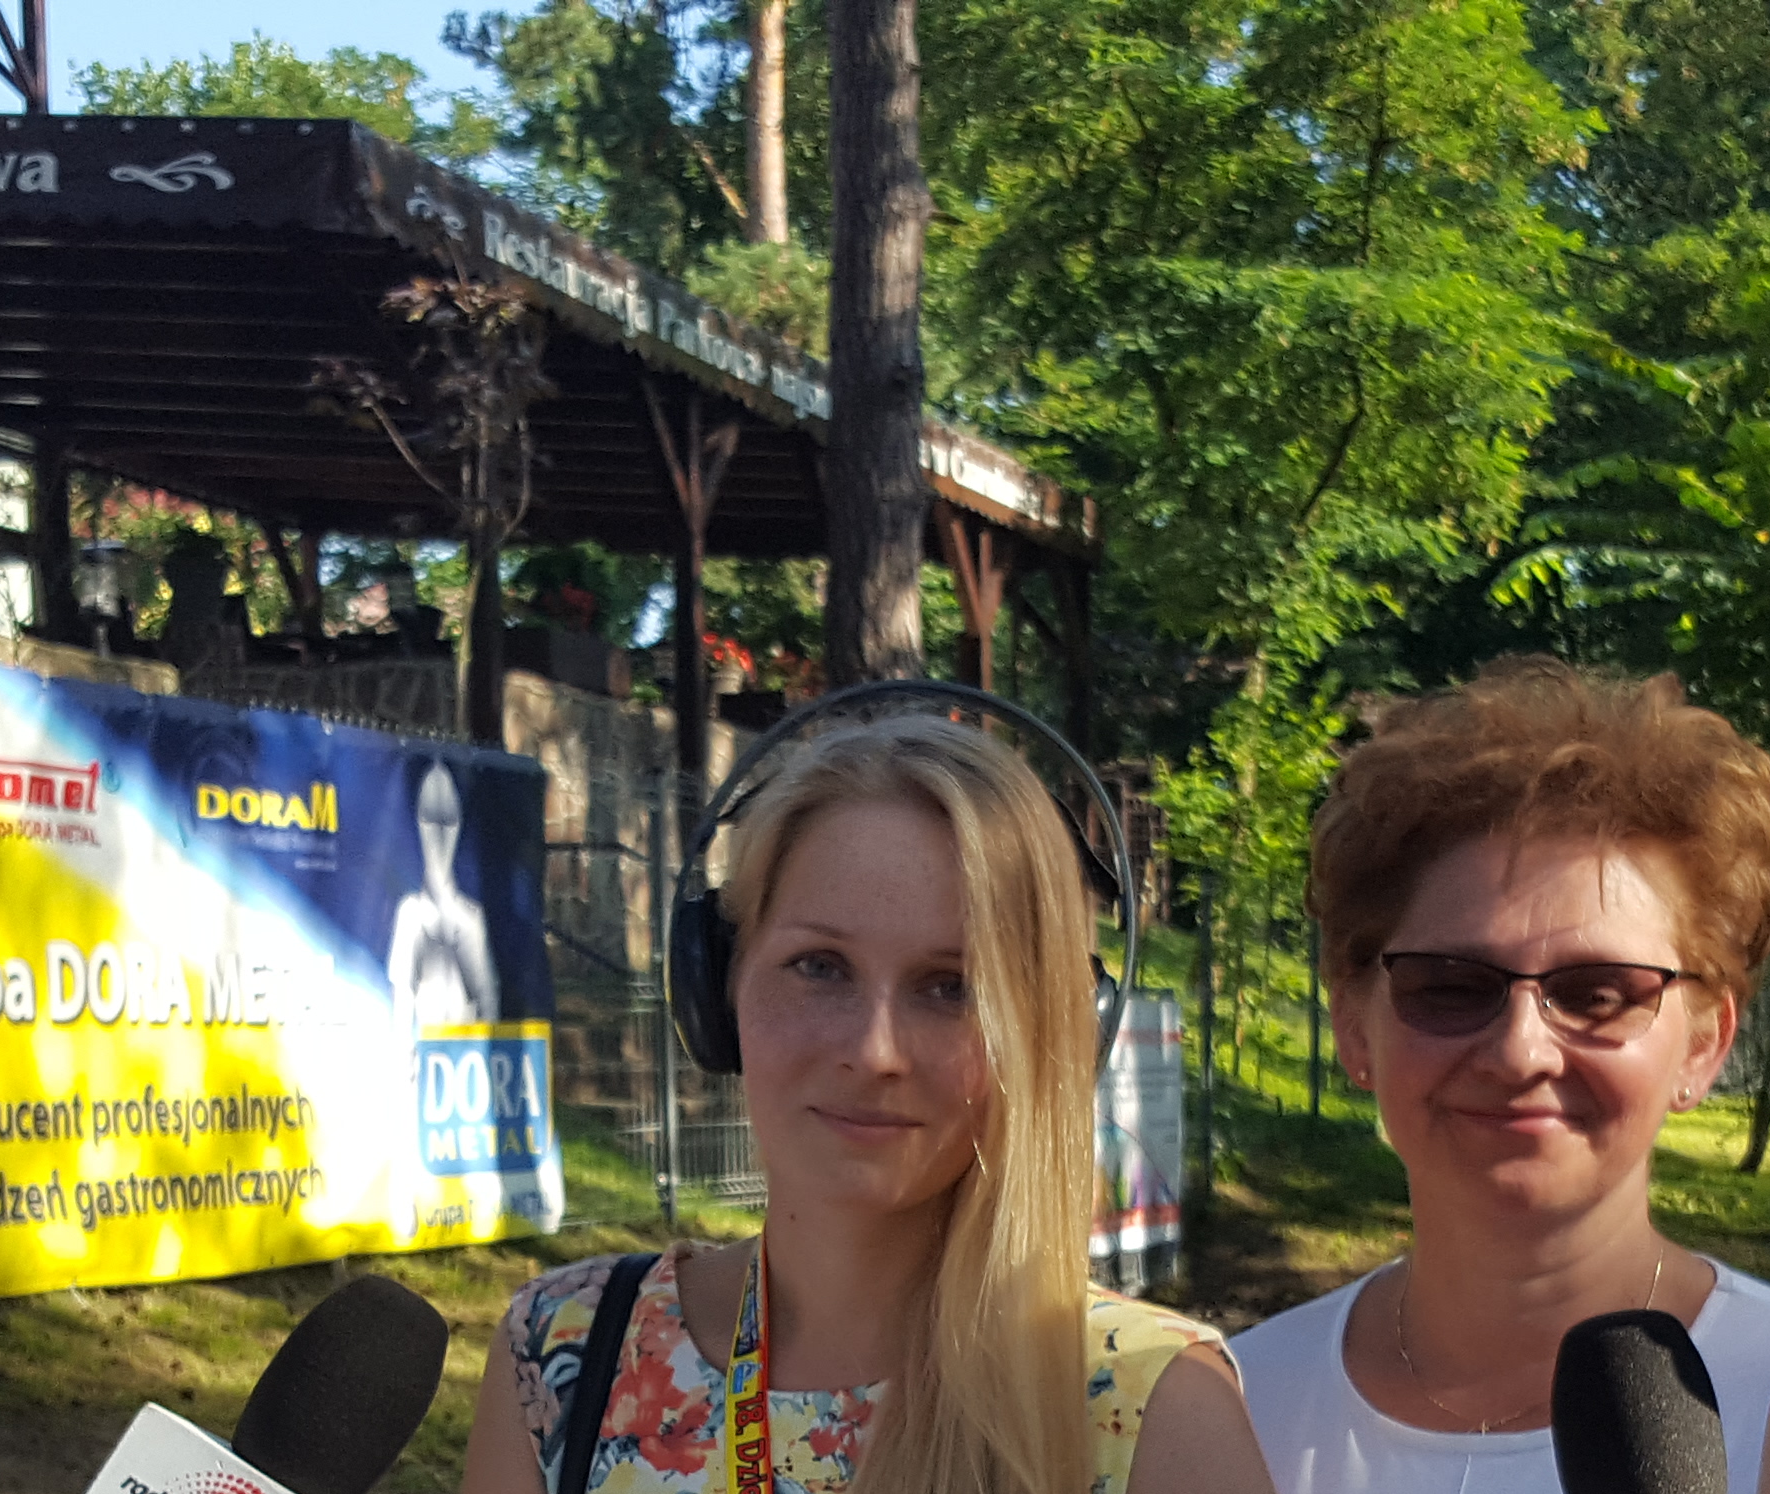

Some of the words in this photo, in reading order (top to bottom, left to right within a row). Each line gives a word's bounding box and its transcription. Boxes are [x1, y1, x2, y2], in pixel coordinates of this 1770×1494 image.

[45, 939, 193, 1027] DORA
[91, 1083, 316, 1147] profesjonalnych
[423, 1051, 541, 1124] DORA
[428, 1126, 543, 1162] METAL
[75, 1159, 325, 1232] gastronomicznych
